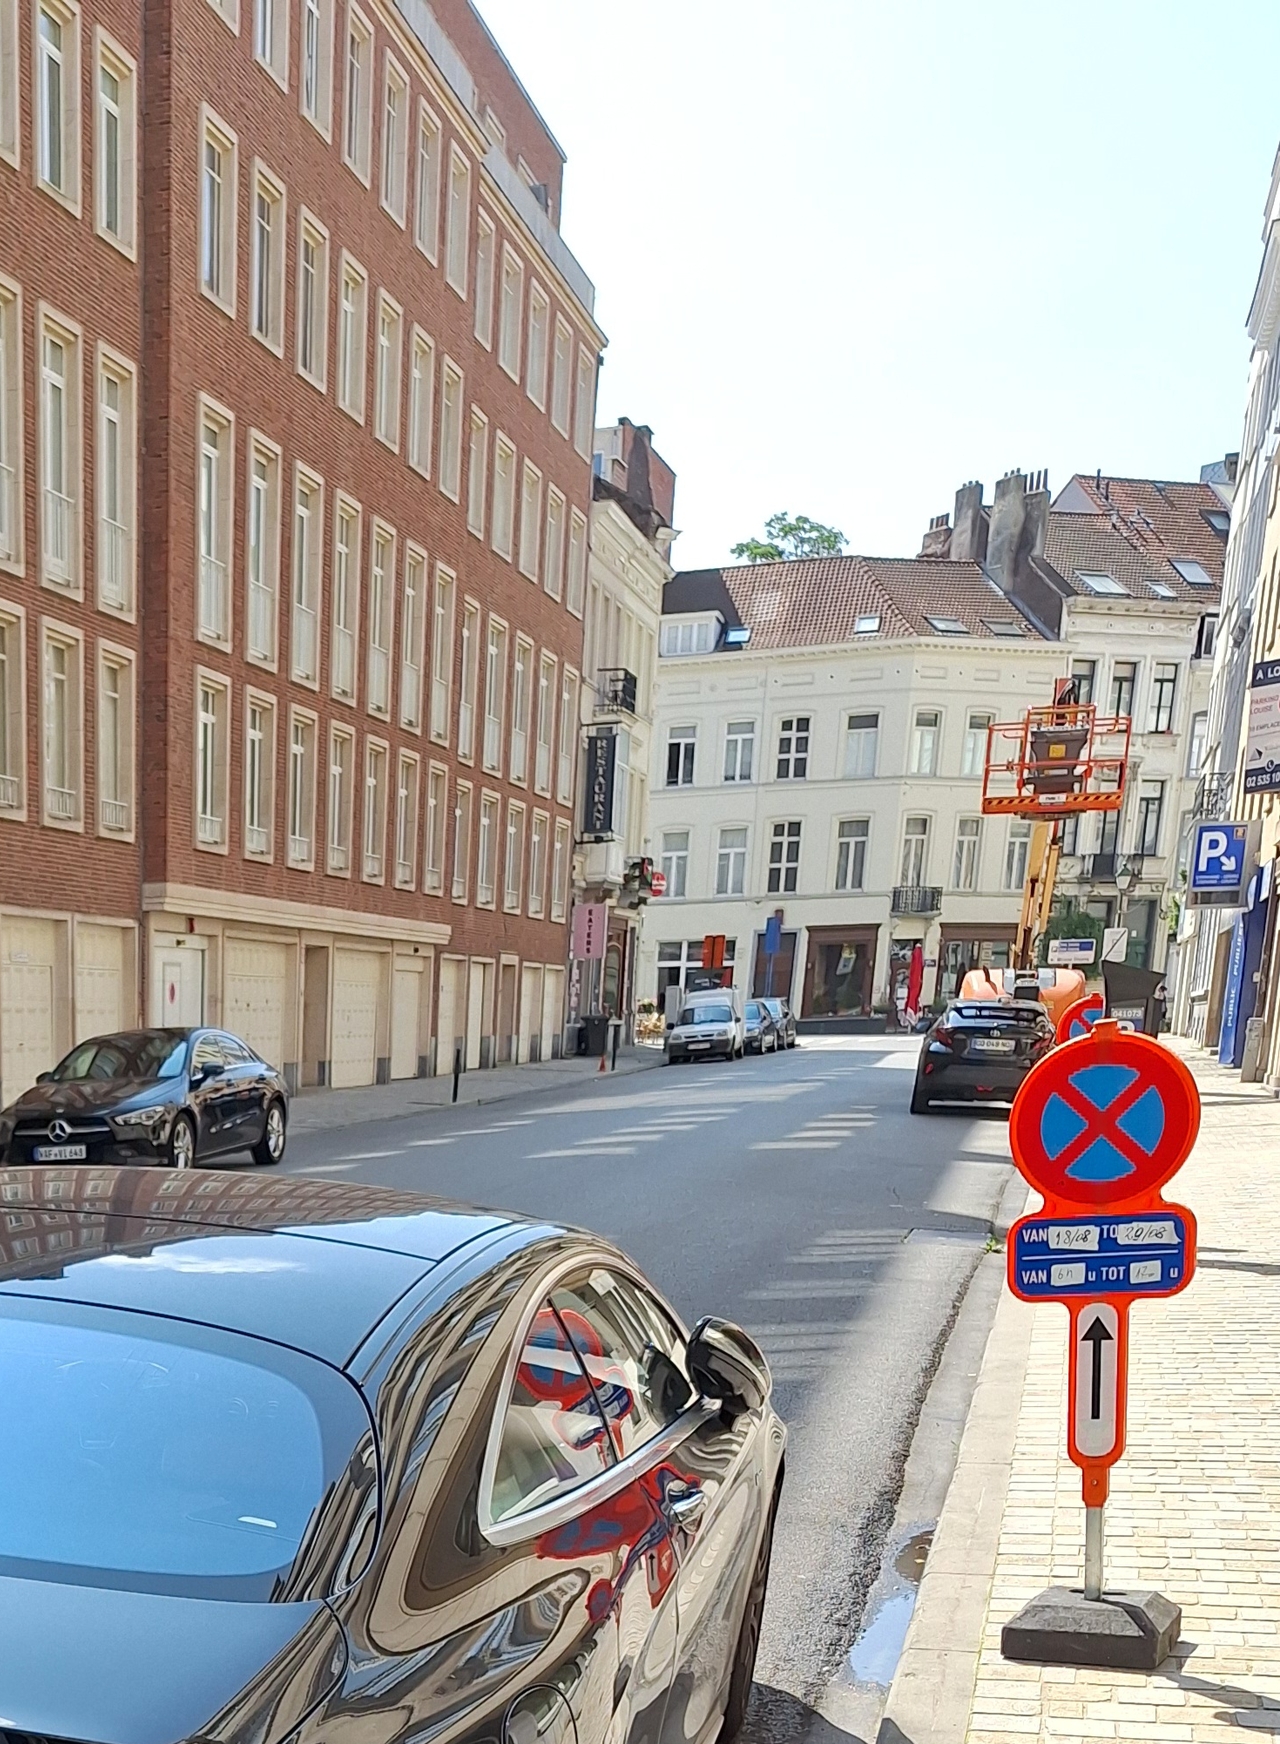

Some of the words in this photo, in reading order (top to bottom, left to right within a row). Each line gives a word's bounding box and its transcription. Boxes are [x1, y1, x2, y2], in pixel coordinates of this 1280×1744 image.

[1256, 669, 1265, 680] A
[593, 738, 608, 830] RESTAURANT
[1246, 776, 1256, 789] 02
[1022, 1228, 1048, 1243] VAN
[1021, 1270, 1047, 1284] VAN
[1100, 1266, 1126, 1281] TOT
